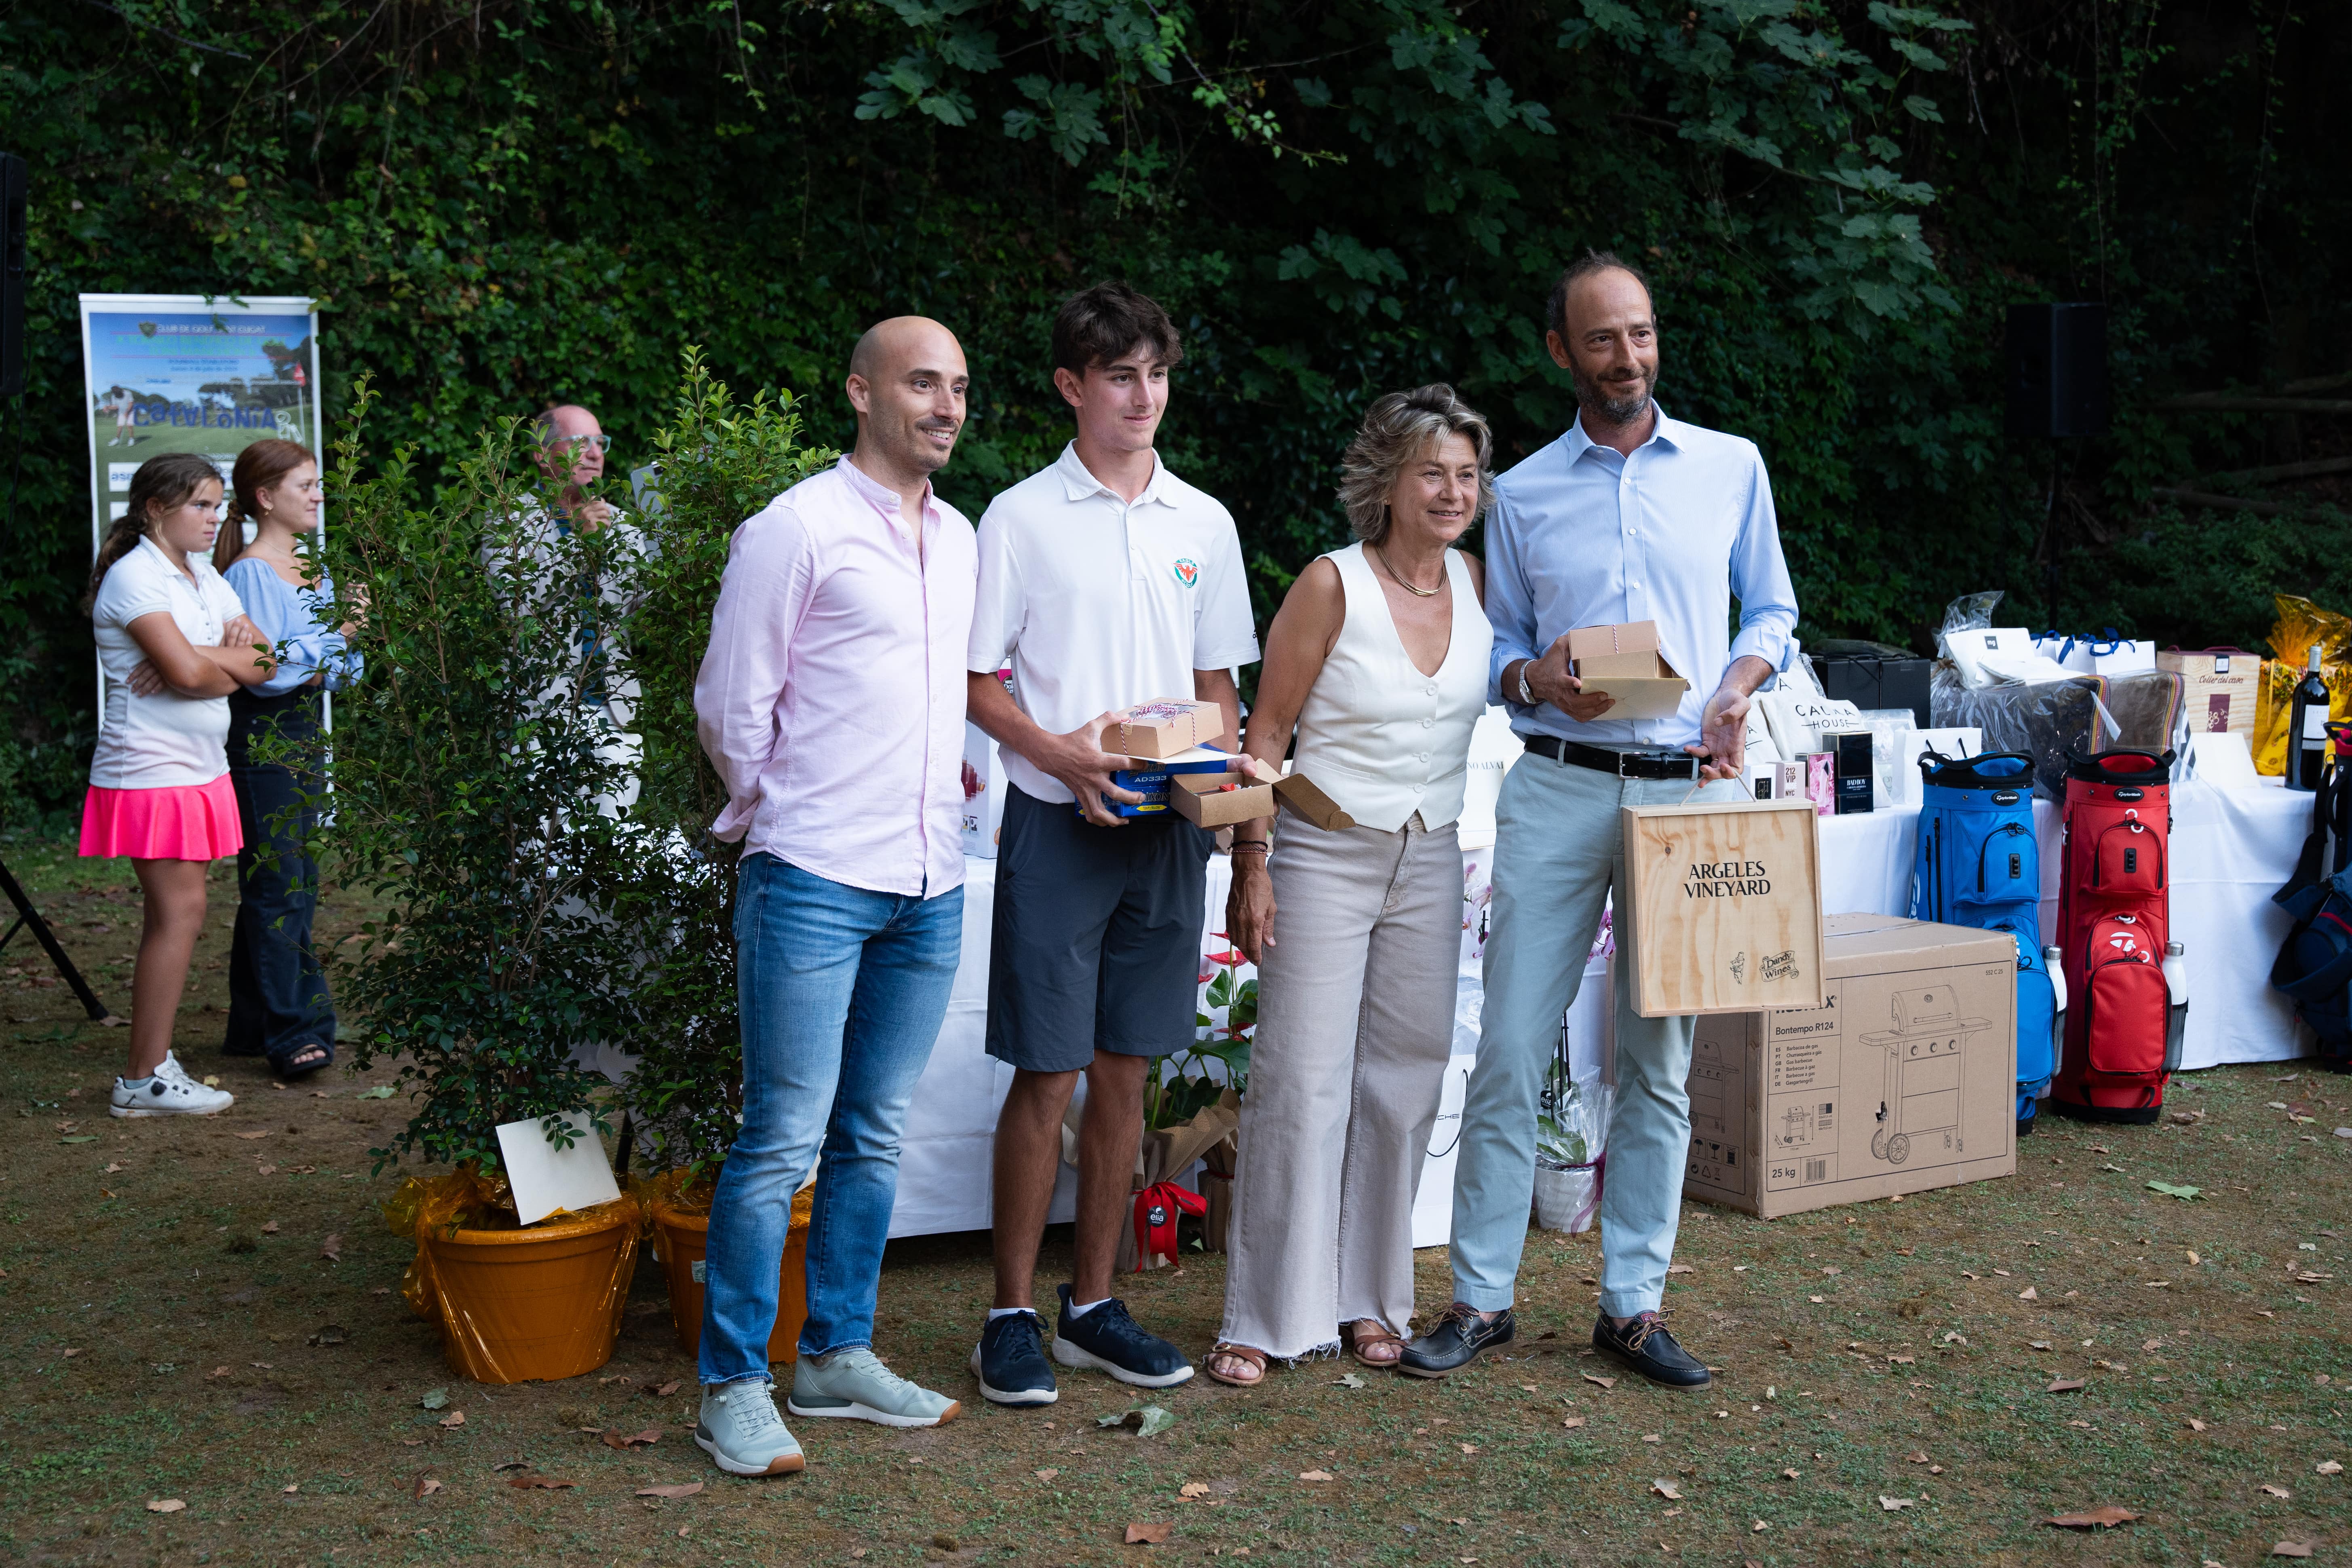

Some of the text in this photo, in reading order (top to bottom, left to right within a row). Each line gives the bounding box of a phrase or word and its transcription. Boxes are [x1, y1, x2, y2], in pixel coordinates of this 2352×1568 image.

[1812, 719, 1850, 729] HOUSE
[1689, 861, 1766, 880] ARGELES
[1683, 879, 1770, 898] VINEYARD
[1767, 953, 1791, 968] Dandy
[1765, 964, 1791, 979] Wines
[1776, 1021, 1833, 1035] Bontempo R124
[1772, 1167, 1795, 1178] 25 kg
